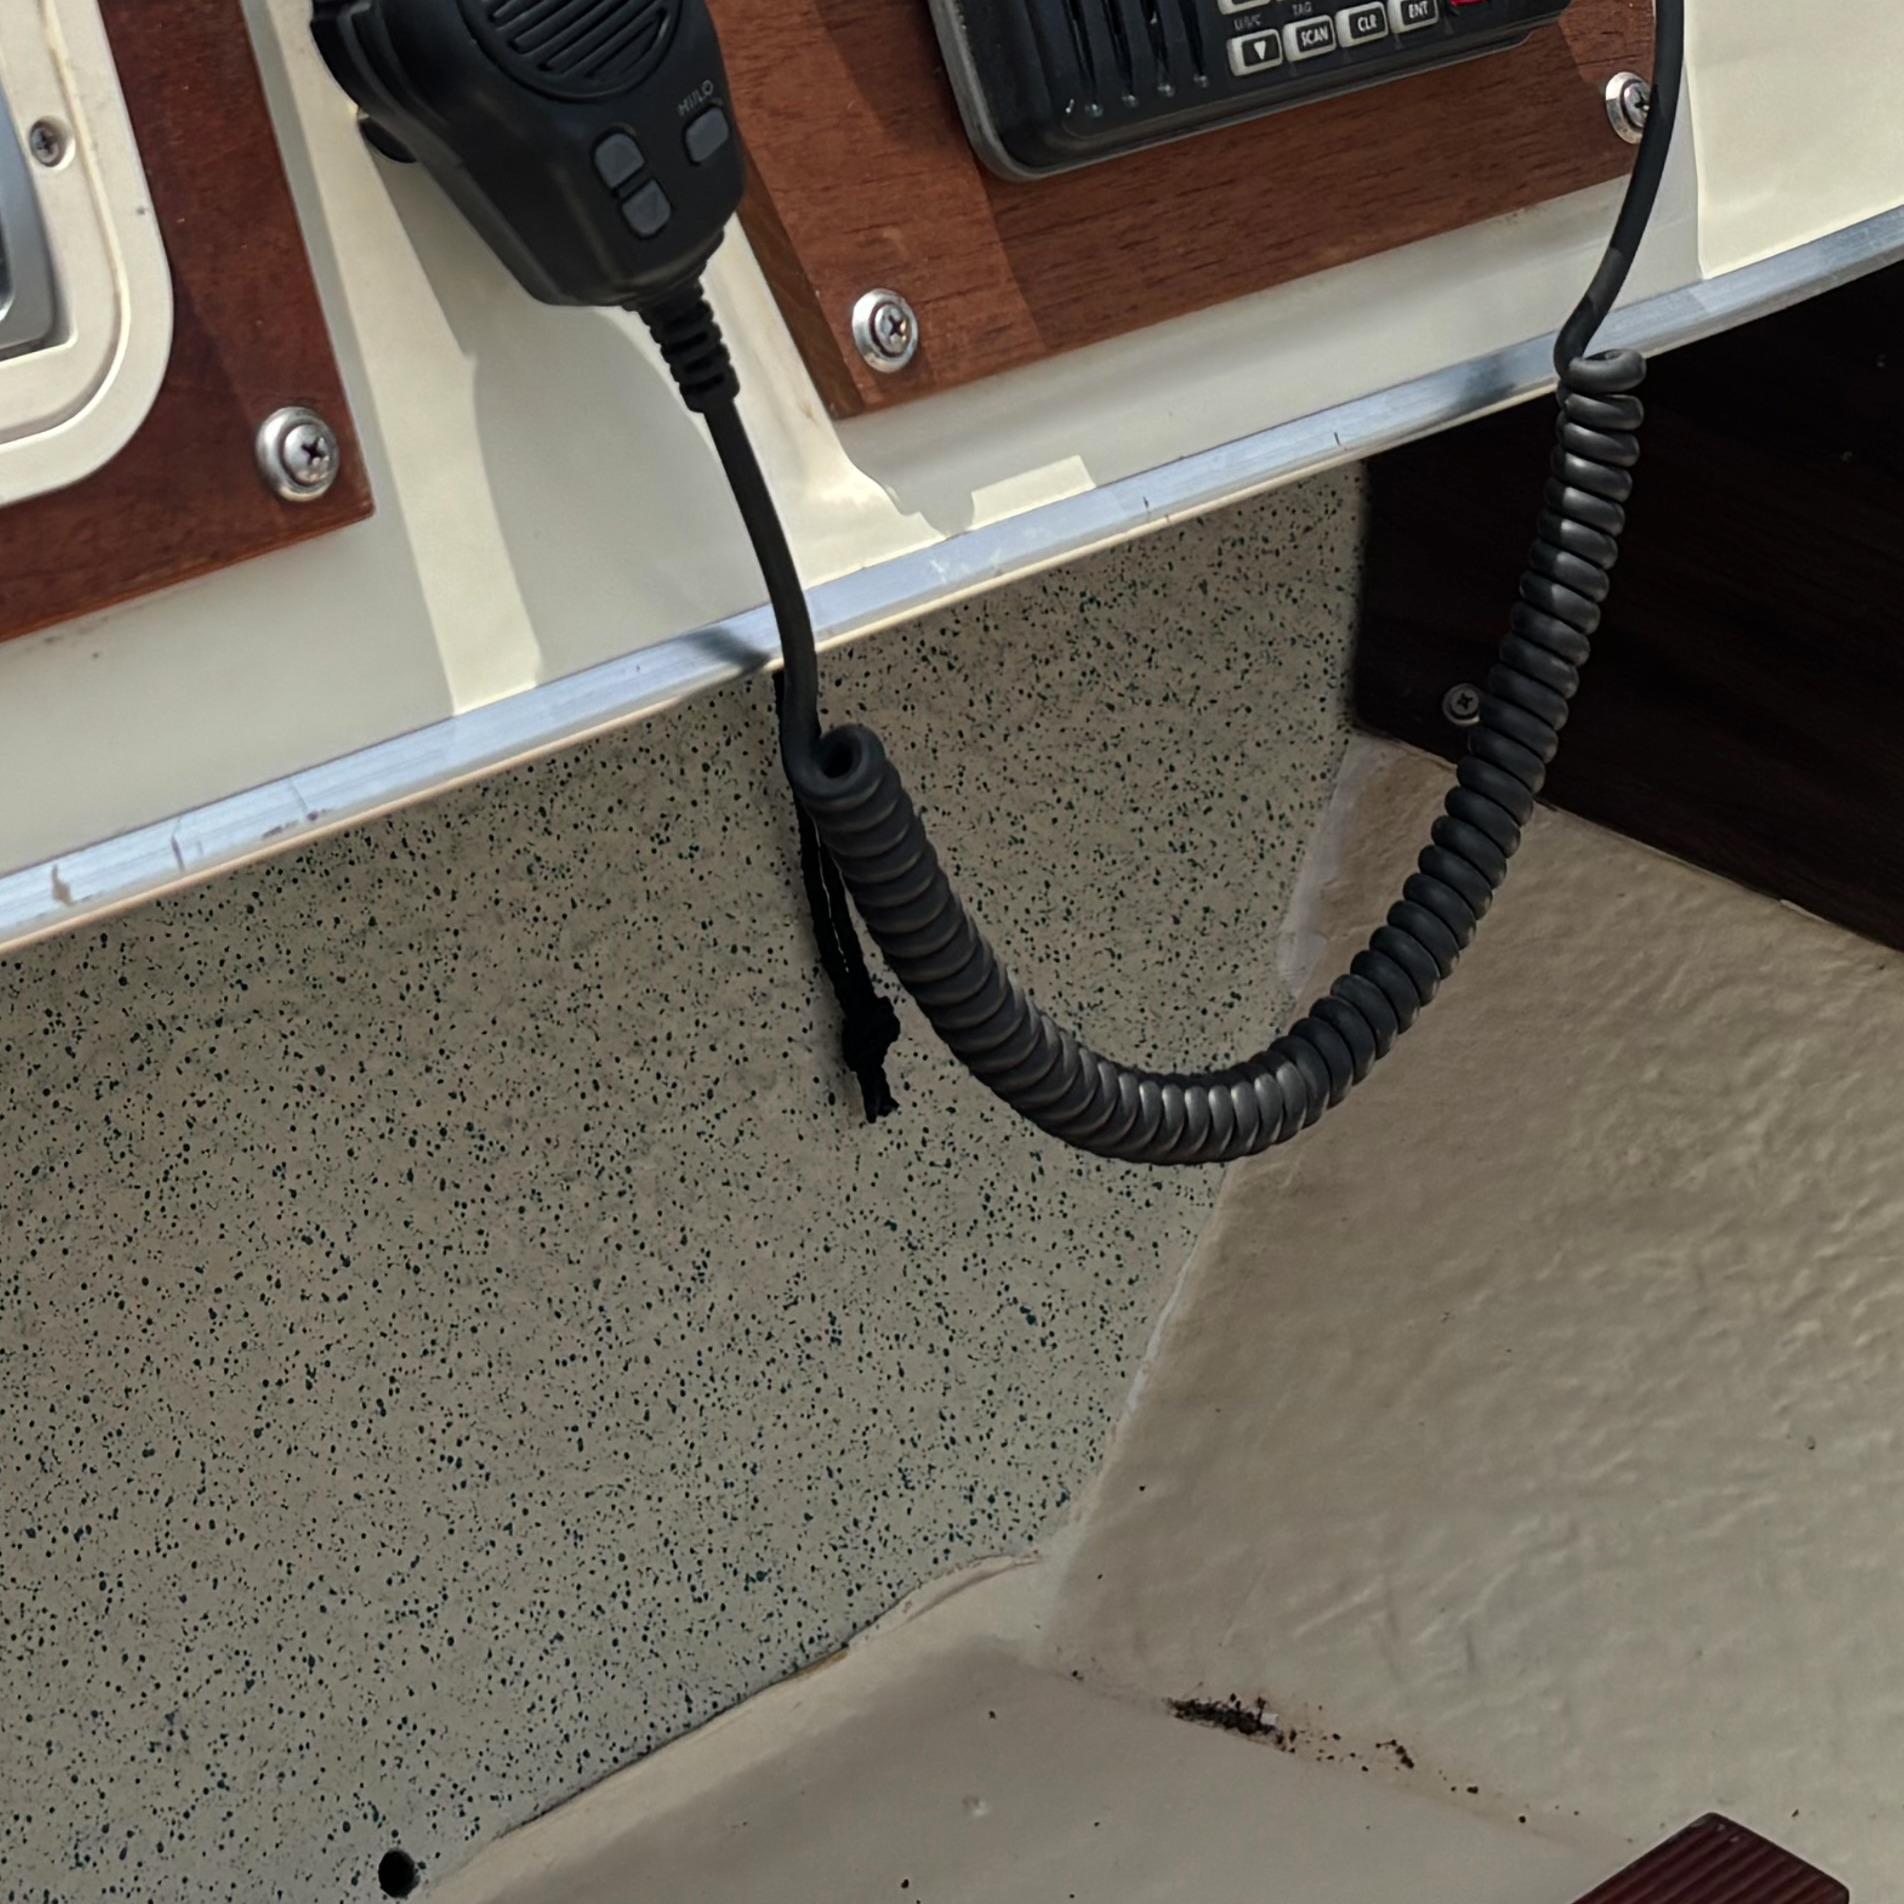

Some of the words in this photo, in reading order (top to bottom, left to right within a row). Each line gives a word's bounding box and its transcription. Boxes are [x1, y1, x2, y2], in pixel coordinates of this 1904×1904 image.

[1408, 0, 1429, 19] ENT
[1357, 13, 1378, 32] CLR
[1300, 25, 1330, 47] SCAN
